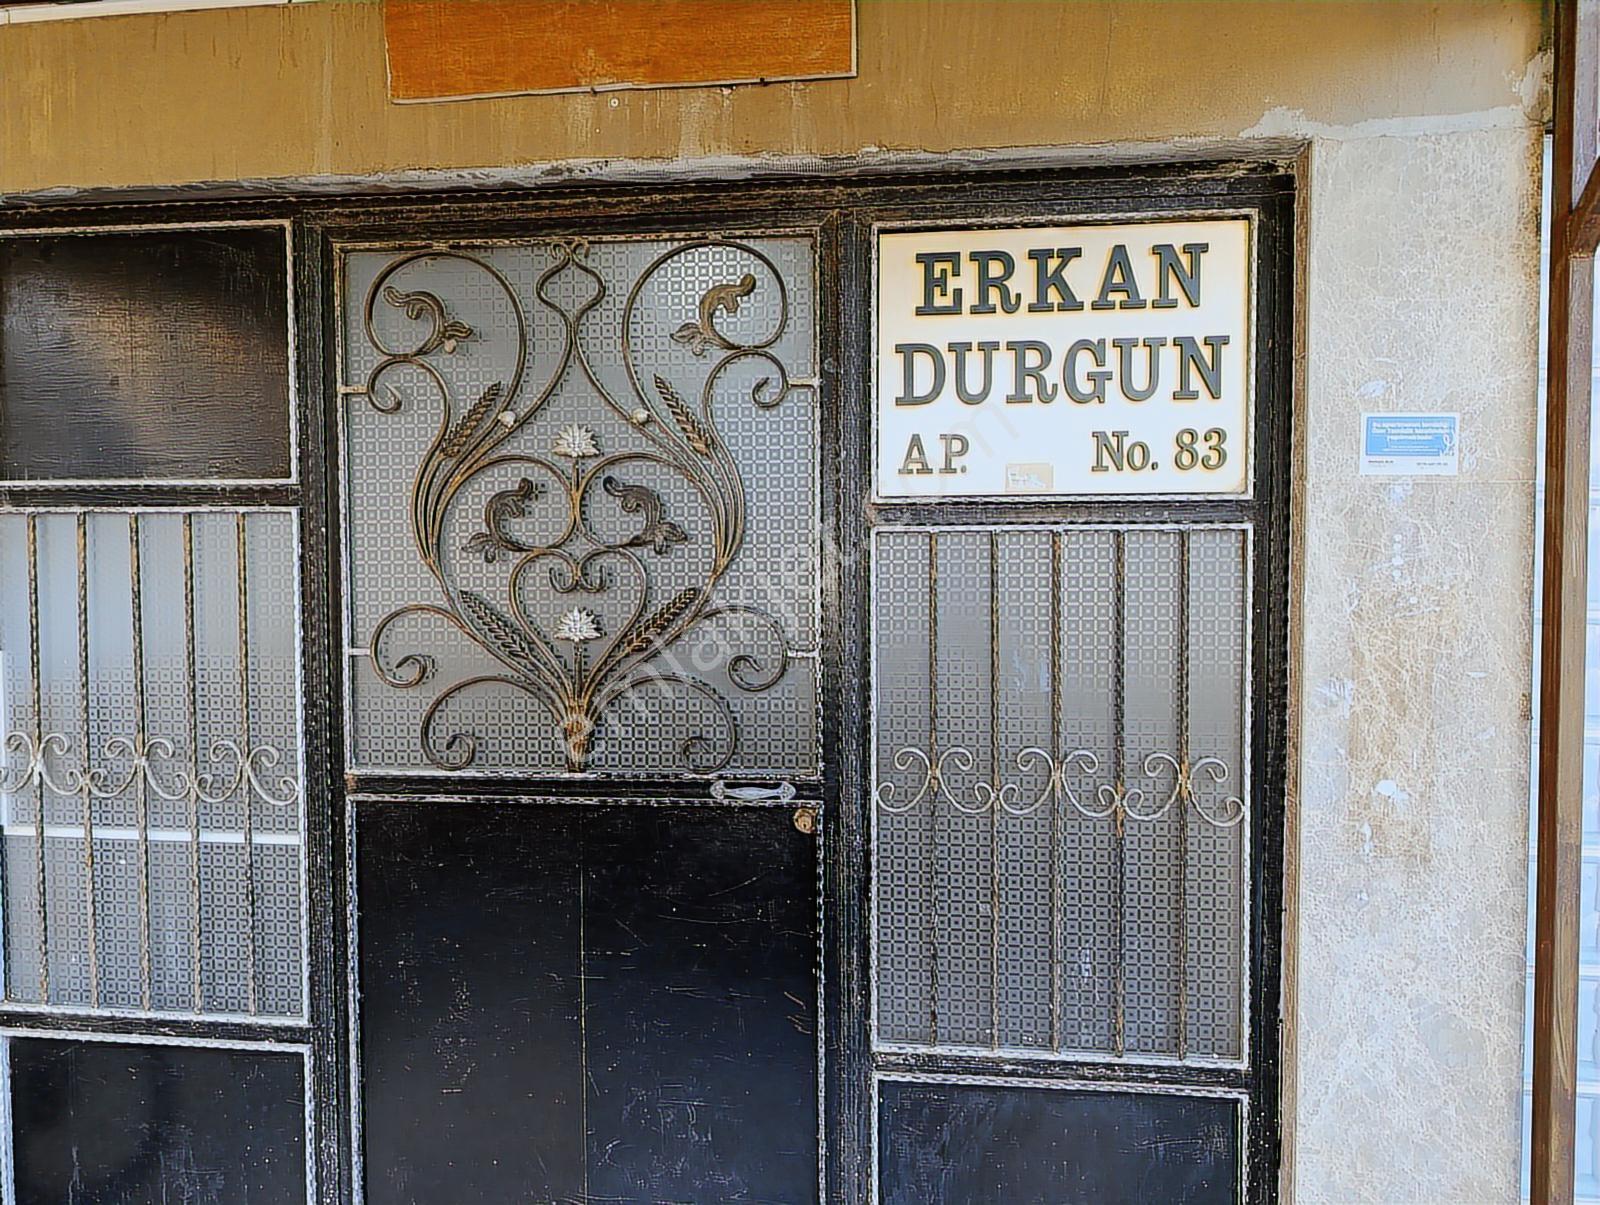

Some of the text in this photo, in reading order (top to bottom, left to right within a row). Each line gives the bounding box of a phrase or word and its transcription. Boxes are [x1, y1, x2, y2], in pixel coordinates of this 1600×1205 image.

[914, 242, 1209, 316] ERKAN
[894, 335, 1231, 407] DURGUN
[897, 427, 1228, 475] AP. No. 83
